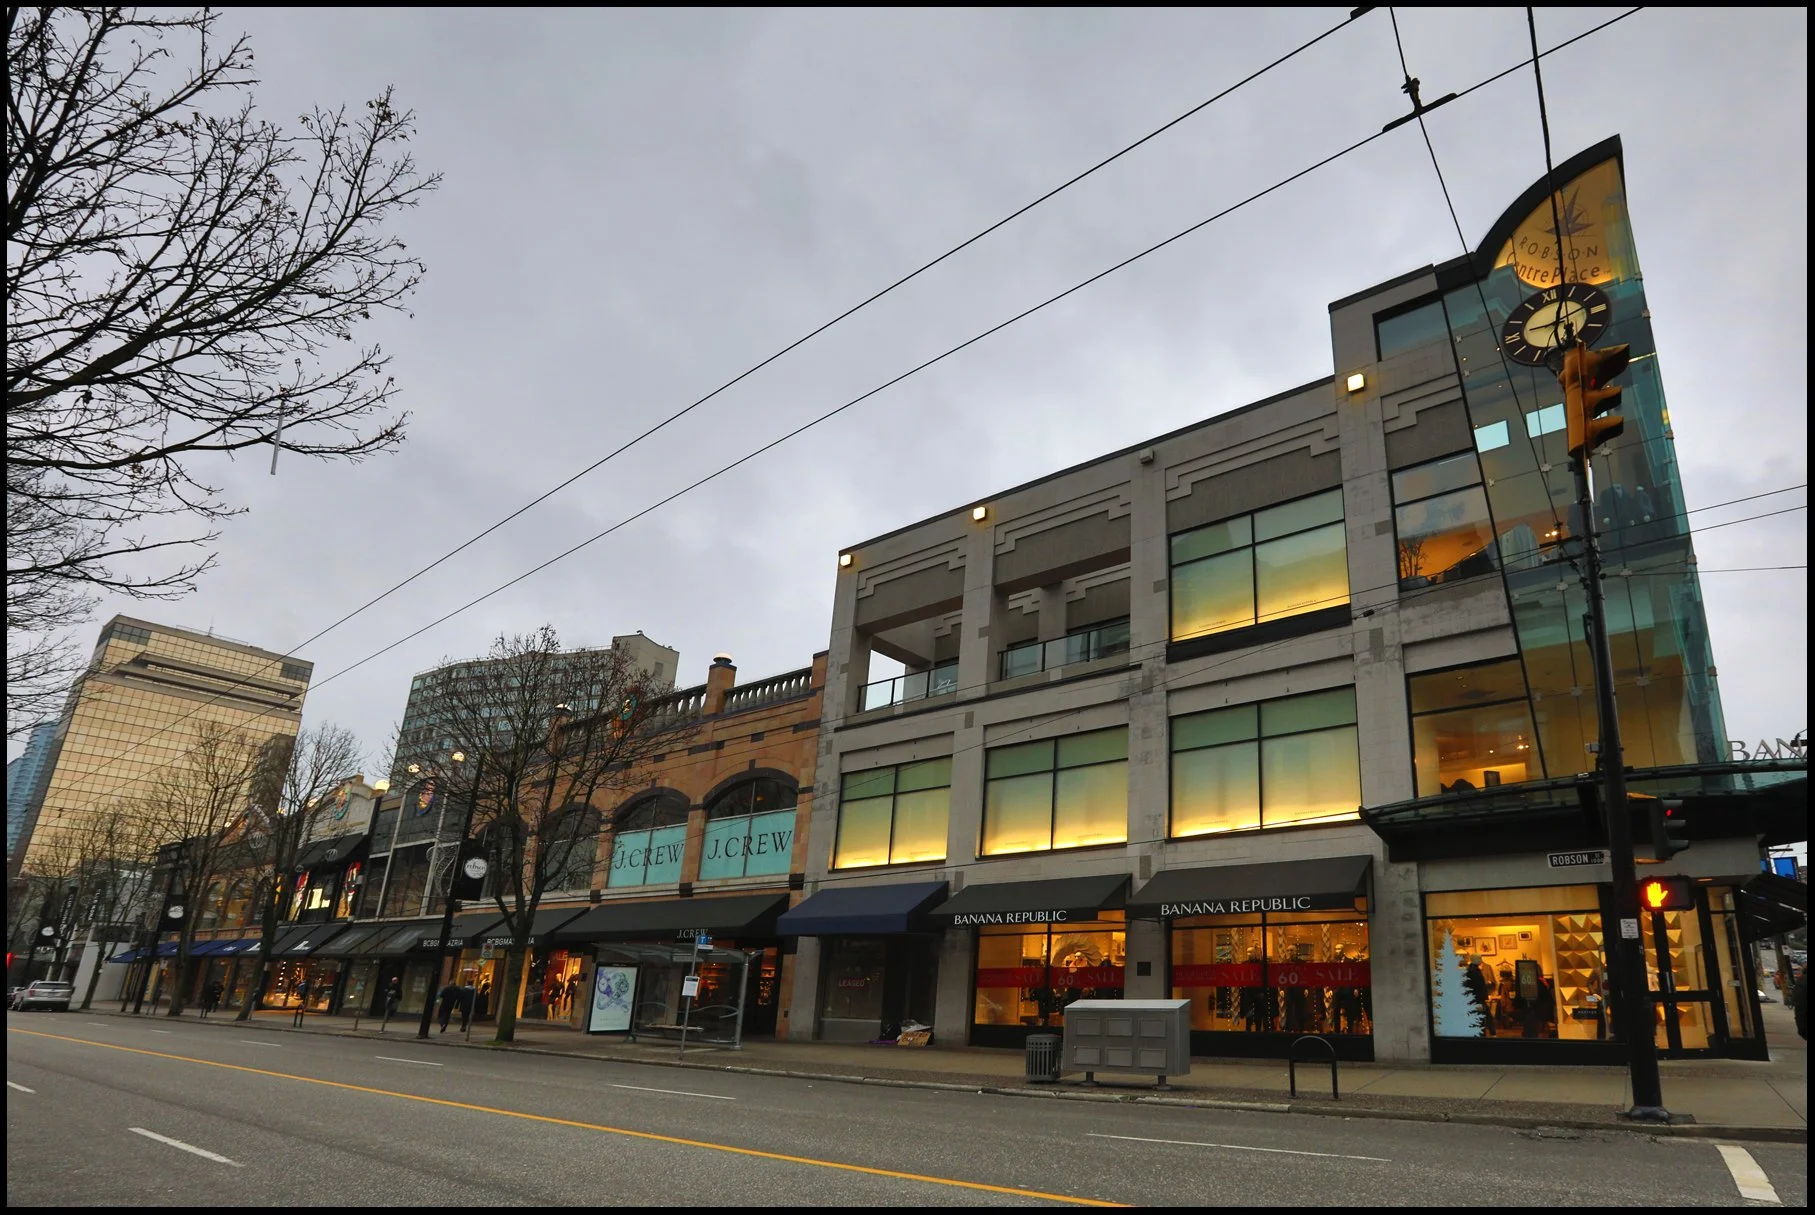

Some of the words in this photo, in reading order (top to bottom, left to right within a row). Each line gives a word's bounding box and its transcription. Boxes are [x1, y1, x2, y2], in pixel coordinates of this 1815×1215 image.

[707, 830, 792, 860] J.CREW
[614, 843, 685, 870] J.CREW
[1552, 853, 1589, 866] ROBSON
[1160, 902, 1226, 916] BANANA
[1230, 896, 1311, 913] REPUBLIC
[954, 914, 1003, 925] BANANA
[1006, 910, 1067, 923] REPUBLIC
[676, 928, 709, 940] J.CREW
[1279, 971, 1298, 985] 60
